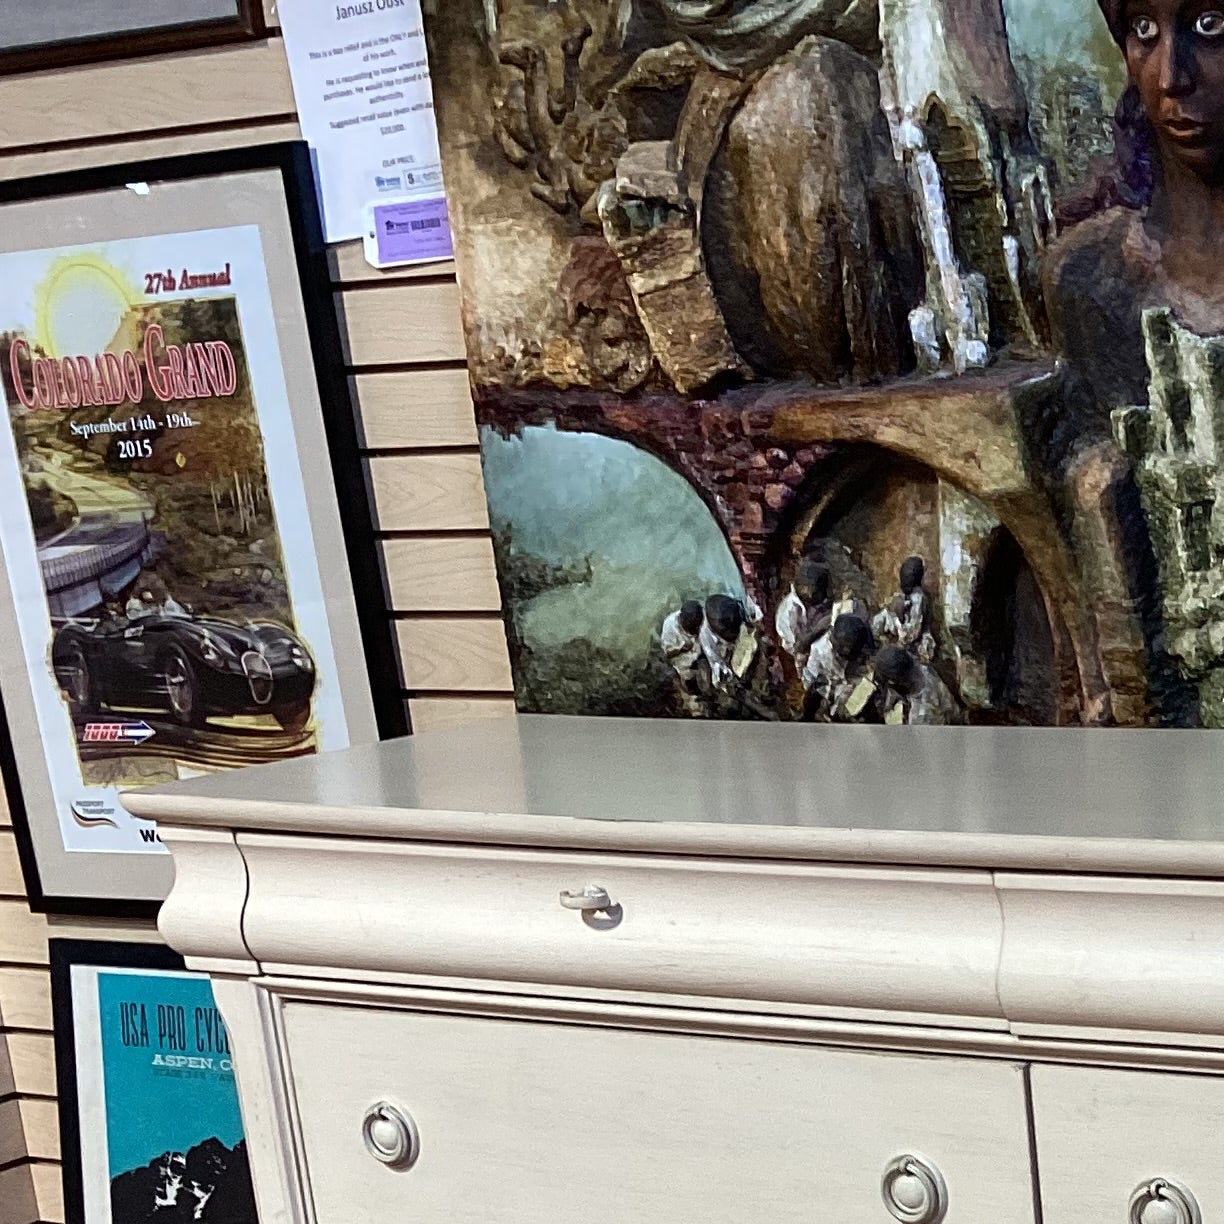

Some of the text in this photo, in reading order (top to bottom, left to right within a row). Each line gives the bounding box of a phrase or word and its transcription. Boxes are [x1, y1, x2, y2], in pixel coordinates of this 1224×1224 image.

[335, 2, 374, 20] Janusz
[144, 262, 231, 294] 27th Annual
[10, 324, 237, 411] COLORADO GRAND
[70, 417, 128, 440] September
[130, 414, 157, 431] 14th
[166, 411, 193, 429] 19th
[117, 438, 152, 458] 2015
[120, 1001, 150, 1048] USA
[157, 1004, 187, 1051] PRO
